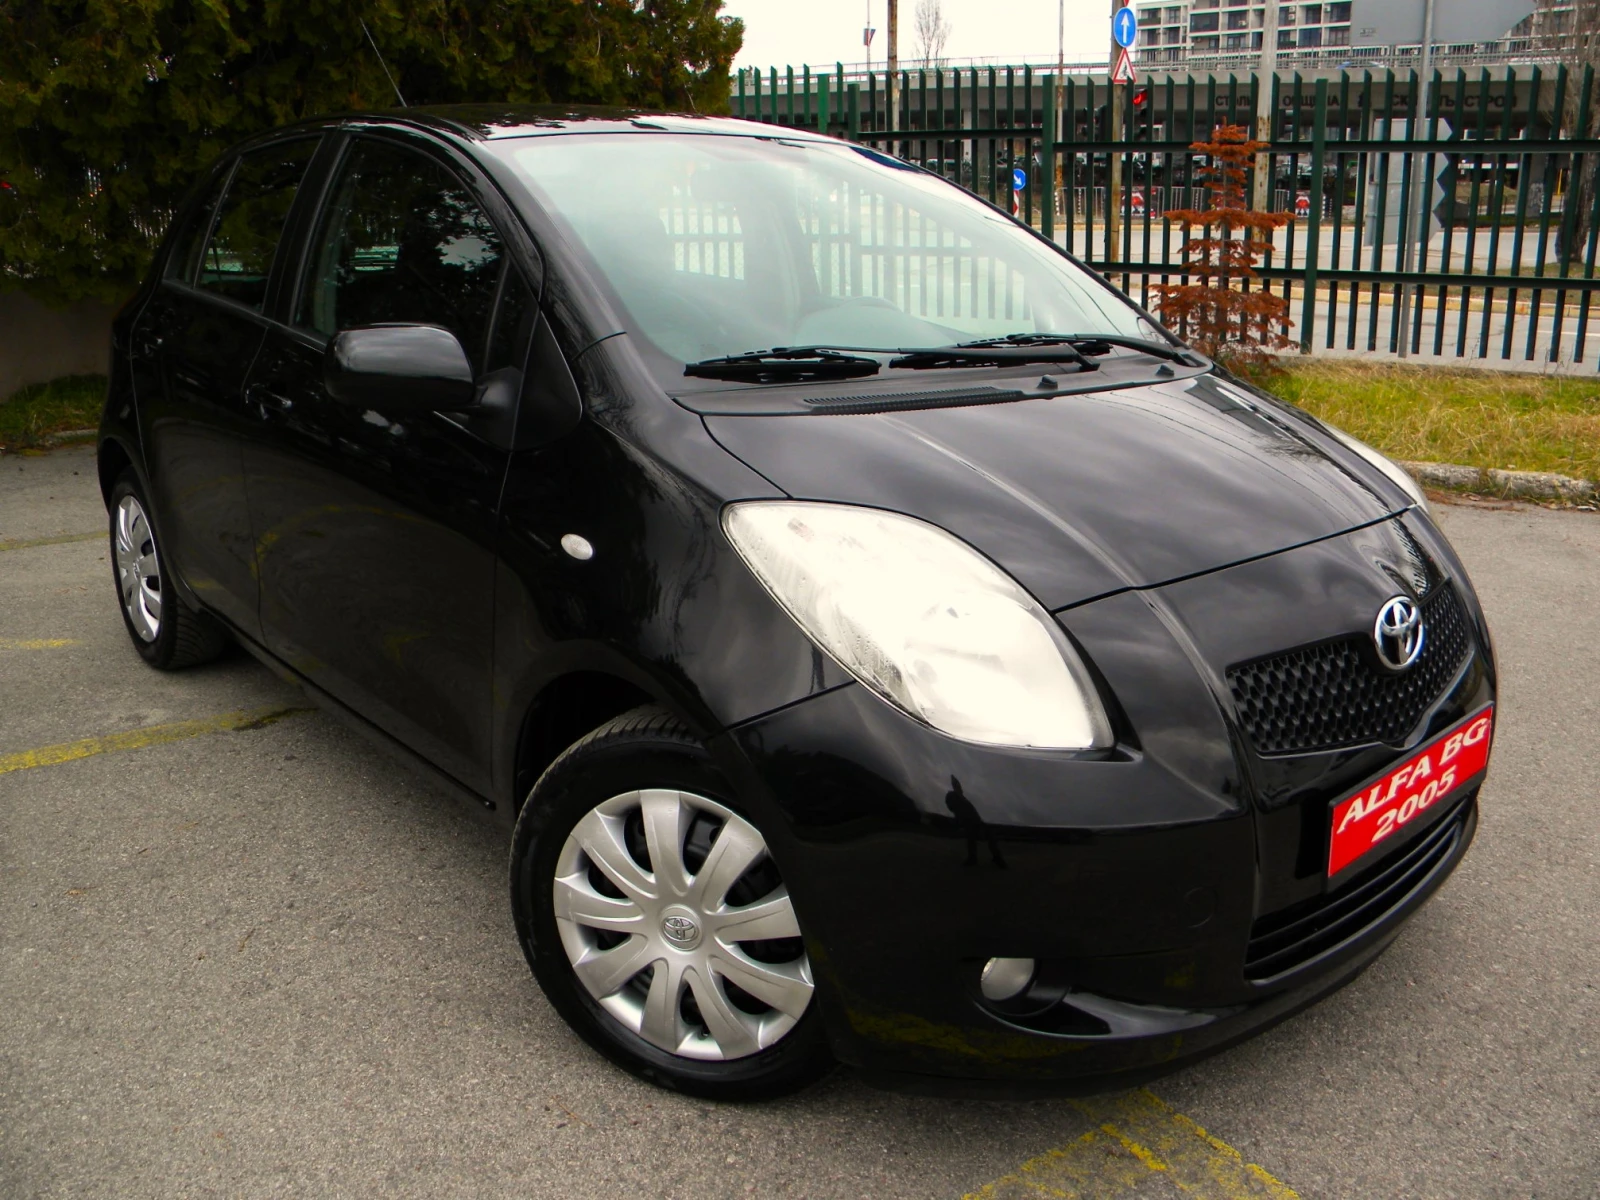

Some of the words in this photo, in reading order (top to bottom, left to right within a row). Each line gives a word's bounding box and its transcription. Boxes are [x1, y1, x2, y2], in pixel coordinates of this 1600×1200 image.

[1336, 755, 1431, 834] ALFA
[1439, 717, 1489, 766] BG
[1371, 765, 1457, 843] 2005
